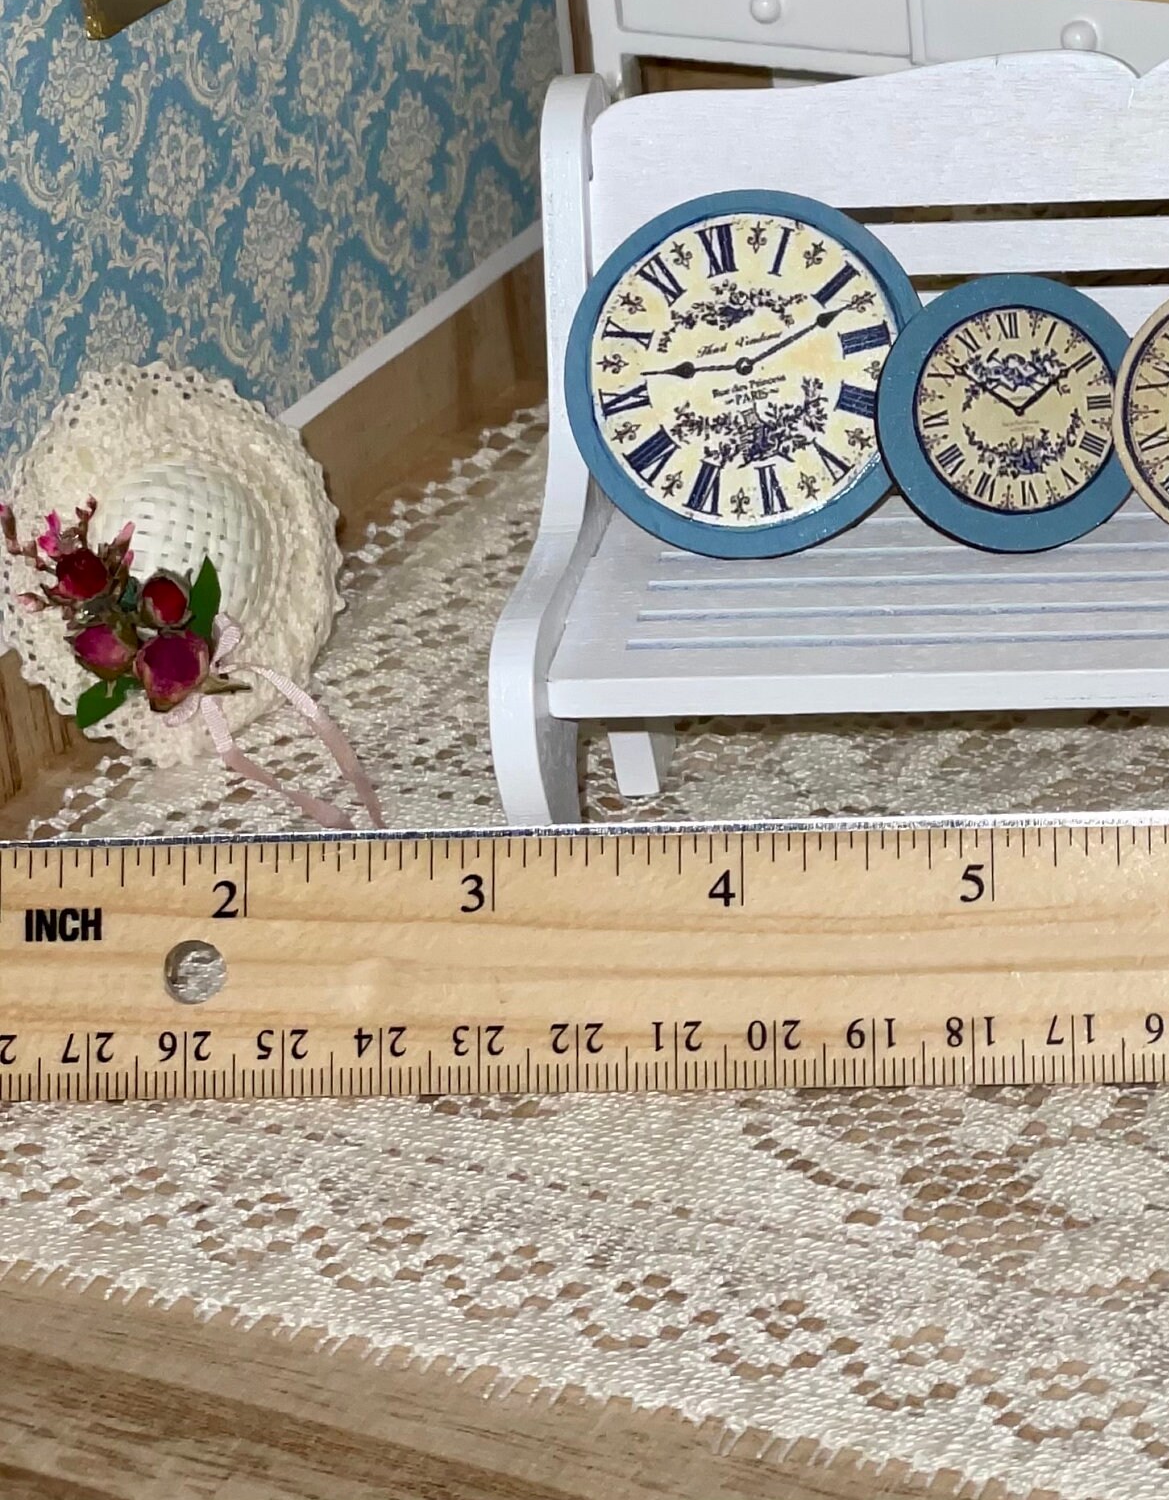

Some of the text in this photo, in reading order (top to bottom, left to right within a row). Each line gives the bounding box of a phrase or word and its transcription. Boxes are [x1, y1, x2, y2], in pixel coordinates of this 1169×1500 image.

[695, 223, 738, 278] XII
[768, 227, 794, 276] I
[635, 252, 686, 307] XI
[812, 261, 861, 307] II
[603, 317, 654, 350] X
[837, 320, 891, 359] III
[599, 380, 651, 417] IX
[812, 439, 854, 485] V
[682, 460, 723, 517] VII
[754, 464, 792, 516] VI
[211, 879, 239, 919] 2
[459, 874, 486, 912] 3
[708, 869, 736, 908] 4
[960, 863, 985, 902] 5
[24, 908, 102, 942] INCH
